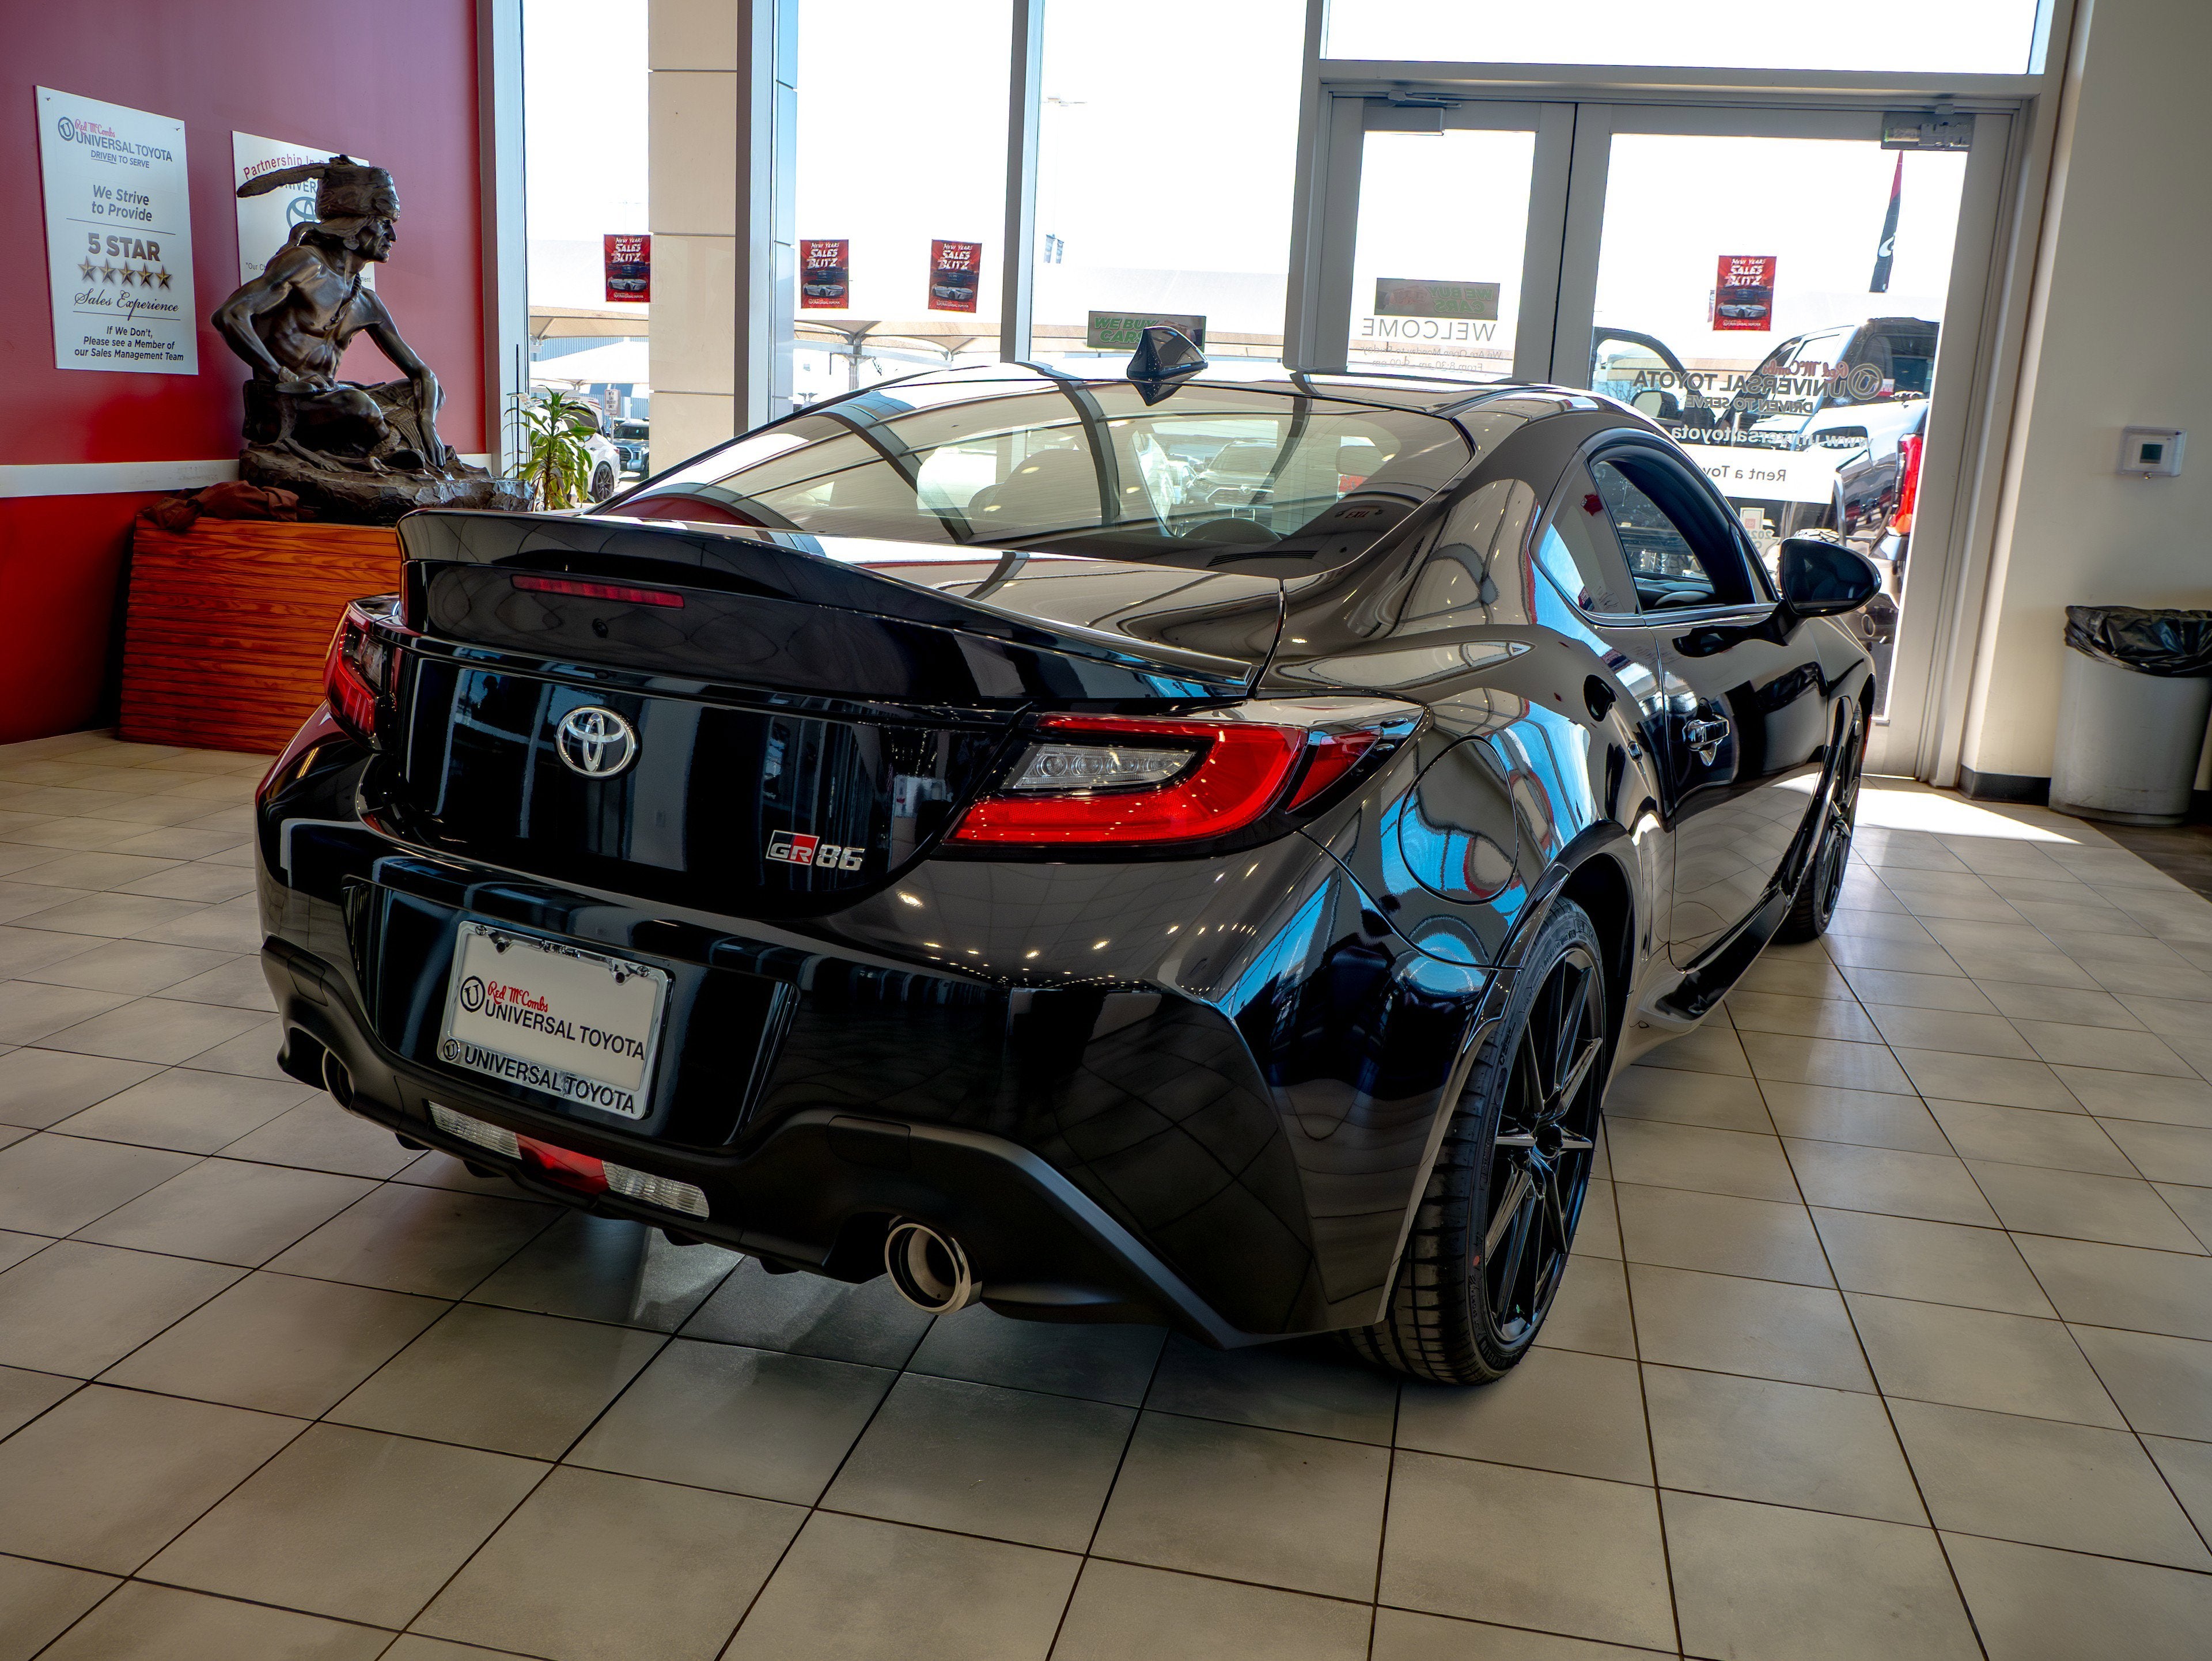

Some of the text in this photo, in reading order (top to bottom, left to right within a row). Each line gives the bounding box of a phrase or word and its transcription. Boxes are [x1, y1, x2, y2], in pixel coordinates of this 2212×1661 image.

[75, 119, 115, 138] Red McCombs
[76, 131, 172, 162] UNIVERSAL TOYOTA
[90, 150, 150, 168] DRIVEN TO SERVE
[243, 153, 302, 180] Partnership
[93, 184, 149, 206] We Strive
[92, 201, 152, 222] to Provide
[88, 232, 161, 262] 5 STAR
[615, 244, 642, 252] SALES
[810, 249, 838, 258] SALES
[942, 249, 971, 260] SALES
[611, 252, 641, 264] BLITZ
[806, 258, 838, 270] BLITZ
[937, 259, 970, 270] BLITZ
[1730, 265, 1763, 275] SALES
[1724, 275, 1763, 287] BLITZ
[74, 288, 179, 321] Sales Experience
[106, 326, 113, 335] If
[115, 327, 128, 336] We
[1094, 317, 1158, 330] WE BUY
[83, 336, 109, 346] Please
[112, 339, 125, 347] see
[134, 339, 165, 349] Member
[166, 341, 175, 350] of
[74, 347, 184, 361] our Sales Management Team
[770, 842, 865, 871] GR 86
[487, 981, 548, 1012] Red McCombs
[484, 999, 645, 1060] UNIVERSAL TOYOTA
[464, 1045, 636, 1114] UNIVERSAL TOYOTA
